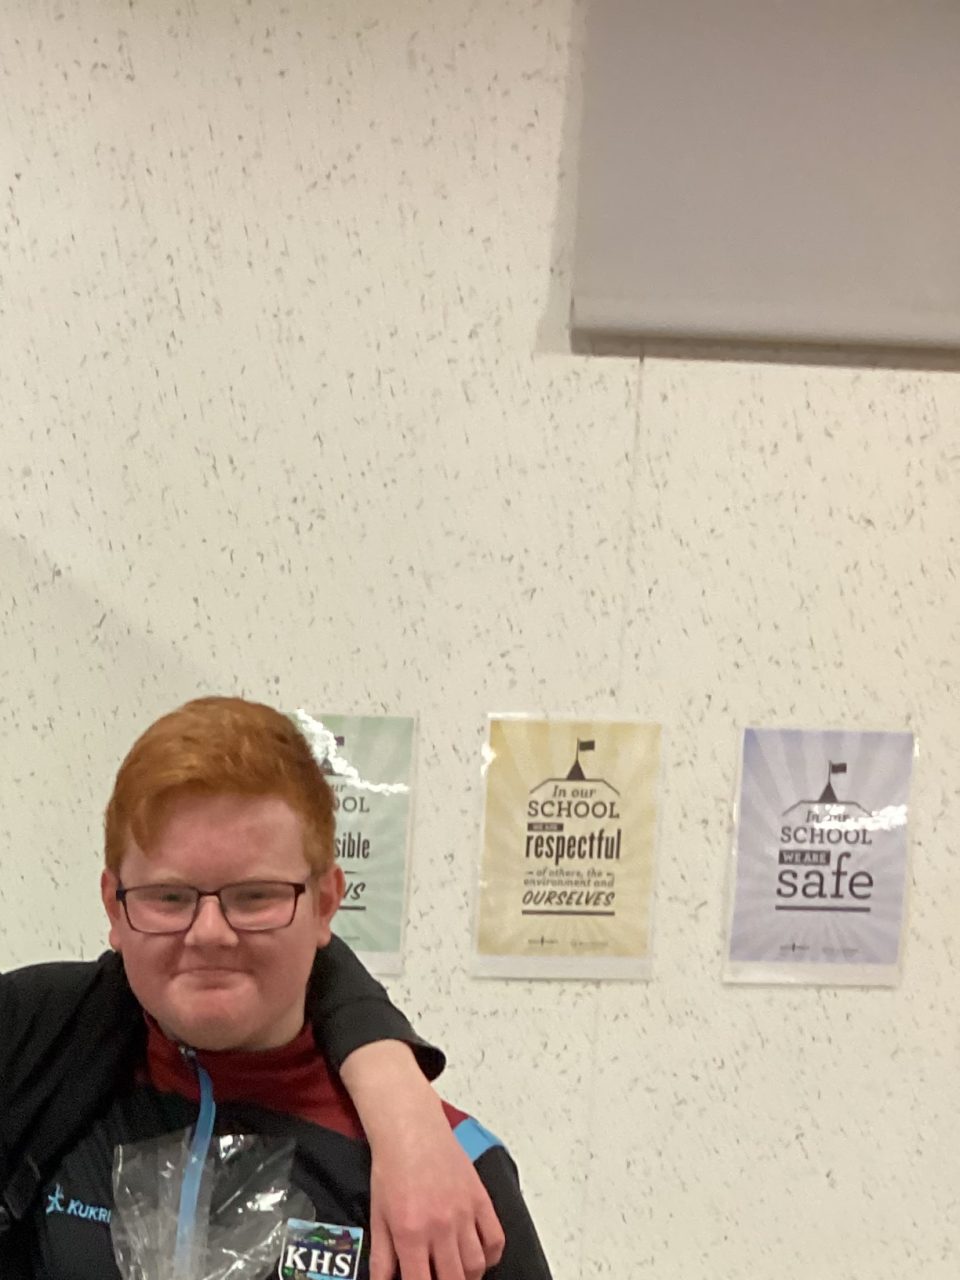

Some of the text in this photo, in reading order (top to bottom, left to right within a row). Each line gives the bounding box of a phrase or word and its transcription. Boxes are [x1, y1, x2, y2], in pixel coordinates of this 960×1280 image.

[552, 784, 597, 799] In our
[527, 799, 620, 820] SCHOOL
[525, 827, 622, 867] respectful
[780, 826, 872, 845] SCHOOL
[776, 851, 874, 900] safe
[521, 889, 616, 907] OURSELVES
[67, 1198, 111, 1224] KUKRI
[284, 1245, 353, 1278] KHS
